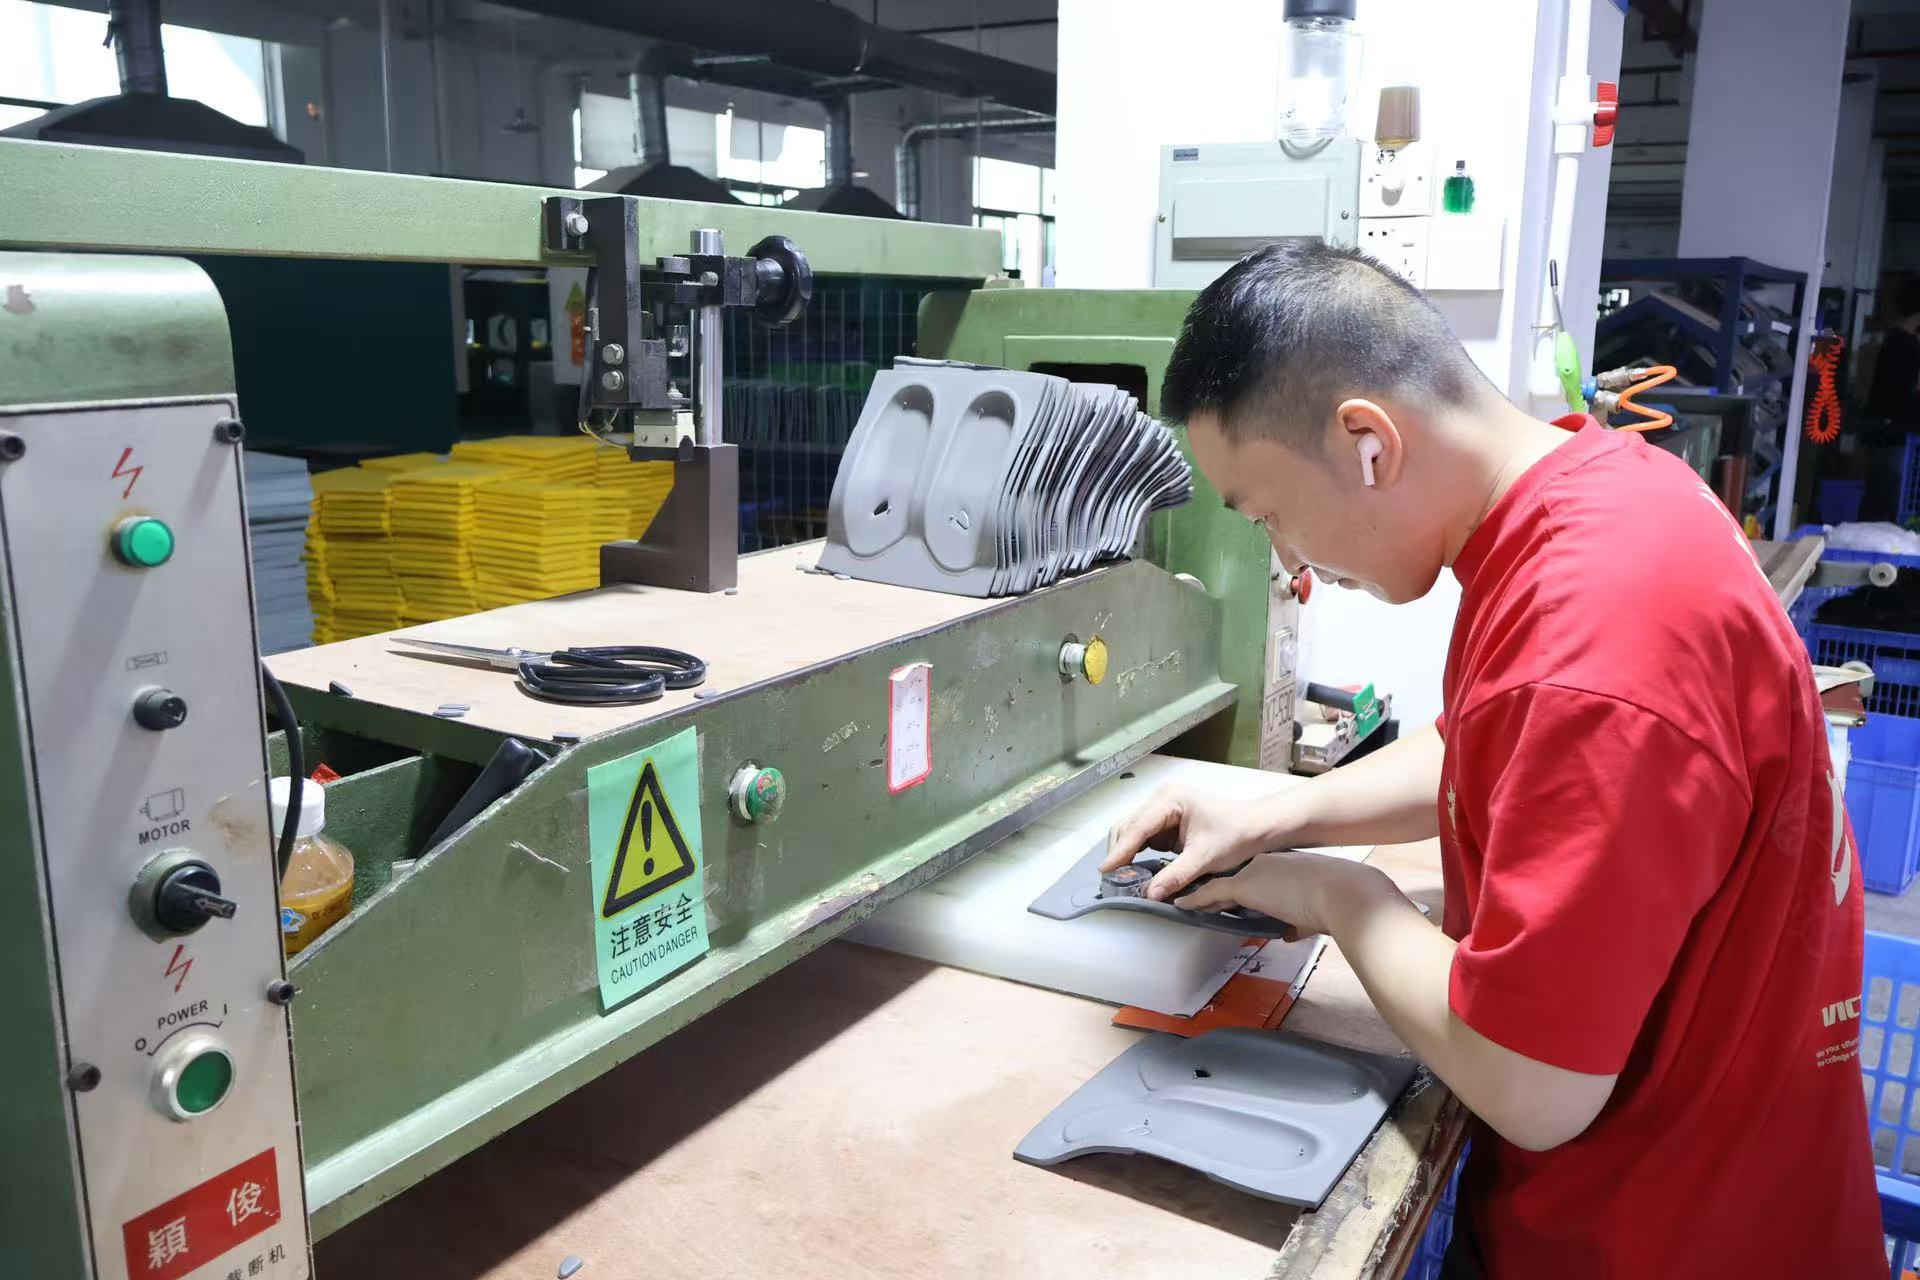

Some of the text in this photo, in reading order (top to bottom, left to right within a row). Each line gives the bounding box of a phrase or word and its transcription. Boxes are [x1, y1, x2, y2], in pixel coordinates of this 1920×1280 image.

[139, 819, 191, 845] MOTOR
[610, 892, 693, 959] 注意安全
[611, 926, 698, 984] CAUTION DANGER
[157, 1000, 208, 1030] POWER
